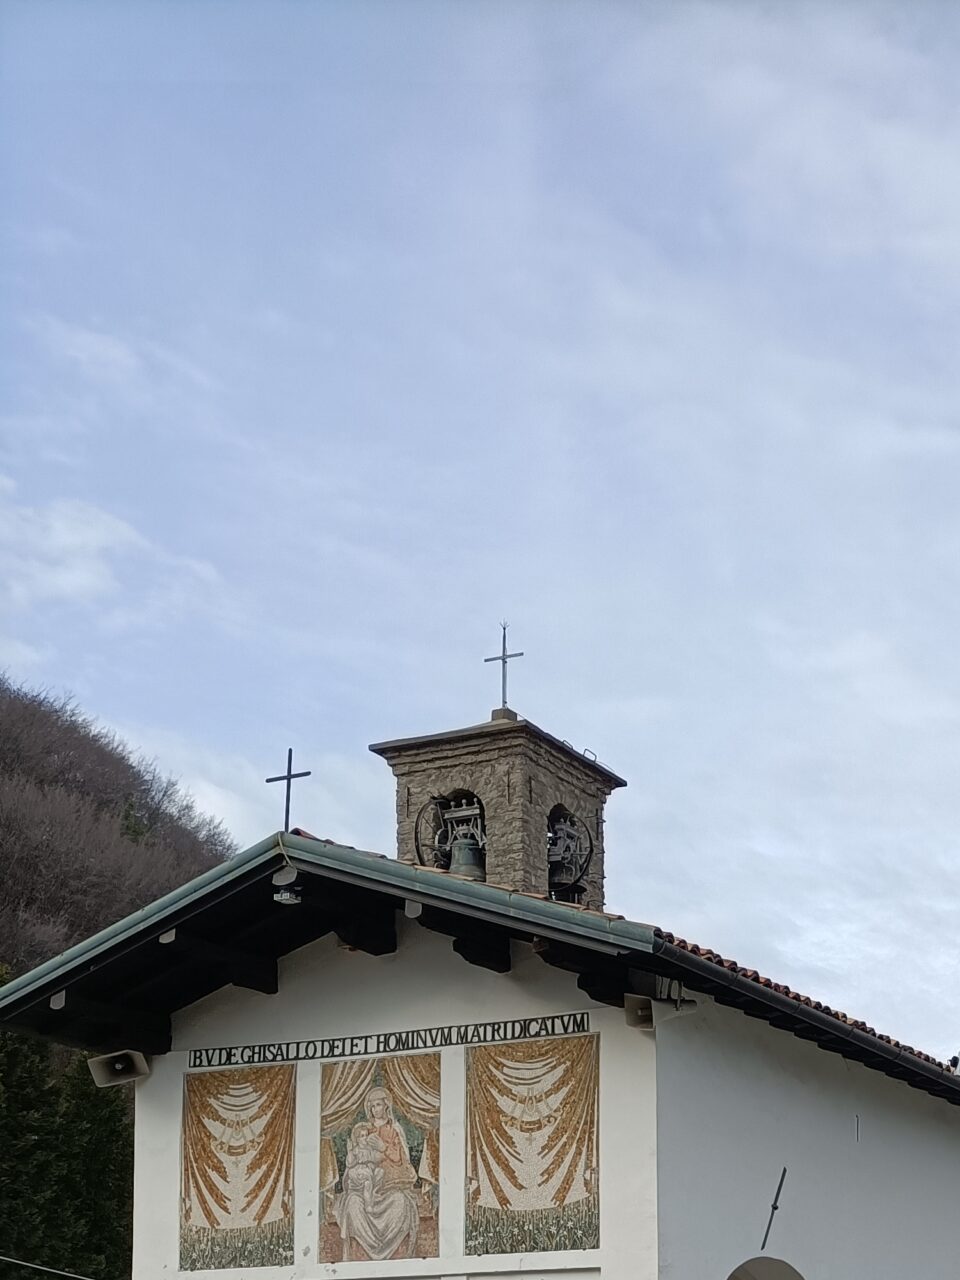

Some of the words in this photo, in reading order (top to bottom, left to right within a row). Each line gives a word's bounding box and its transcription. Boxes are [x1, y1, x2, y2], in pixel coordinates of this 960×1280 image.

[218, 1047, 239, 1065] DE
[240, 1041, 318, 1064] GHISALLO
[321, 1038, 345, 1058] DEI
[350, 1036, 373, 1055] ET
[377, 1027, 452, 1053] HOMINVM
[457, 1021, 507, 1045] MATRI
[511, 1013, 584, 1039] DICATVM
